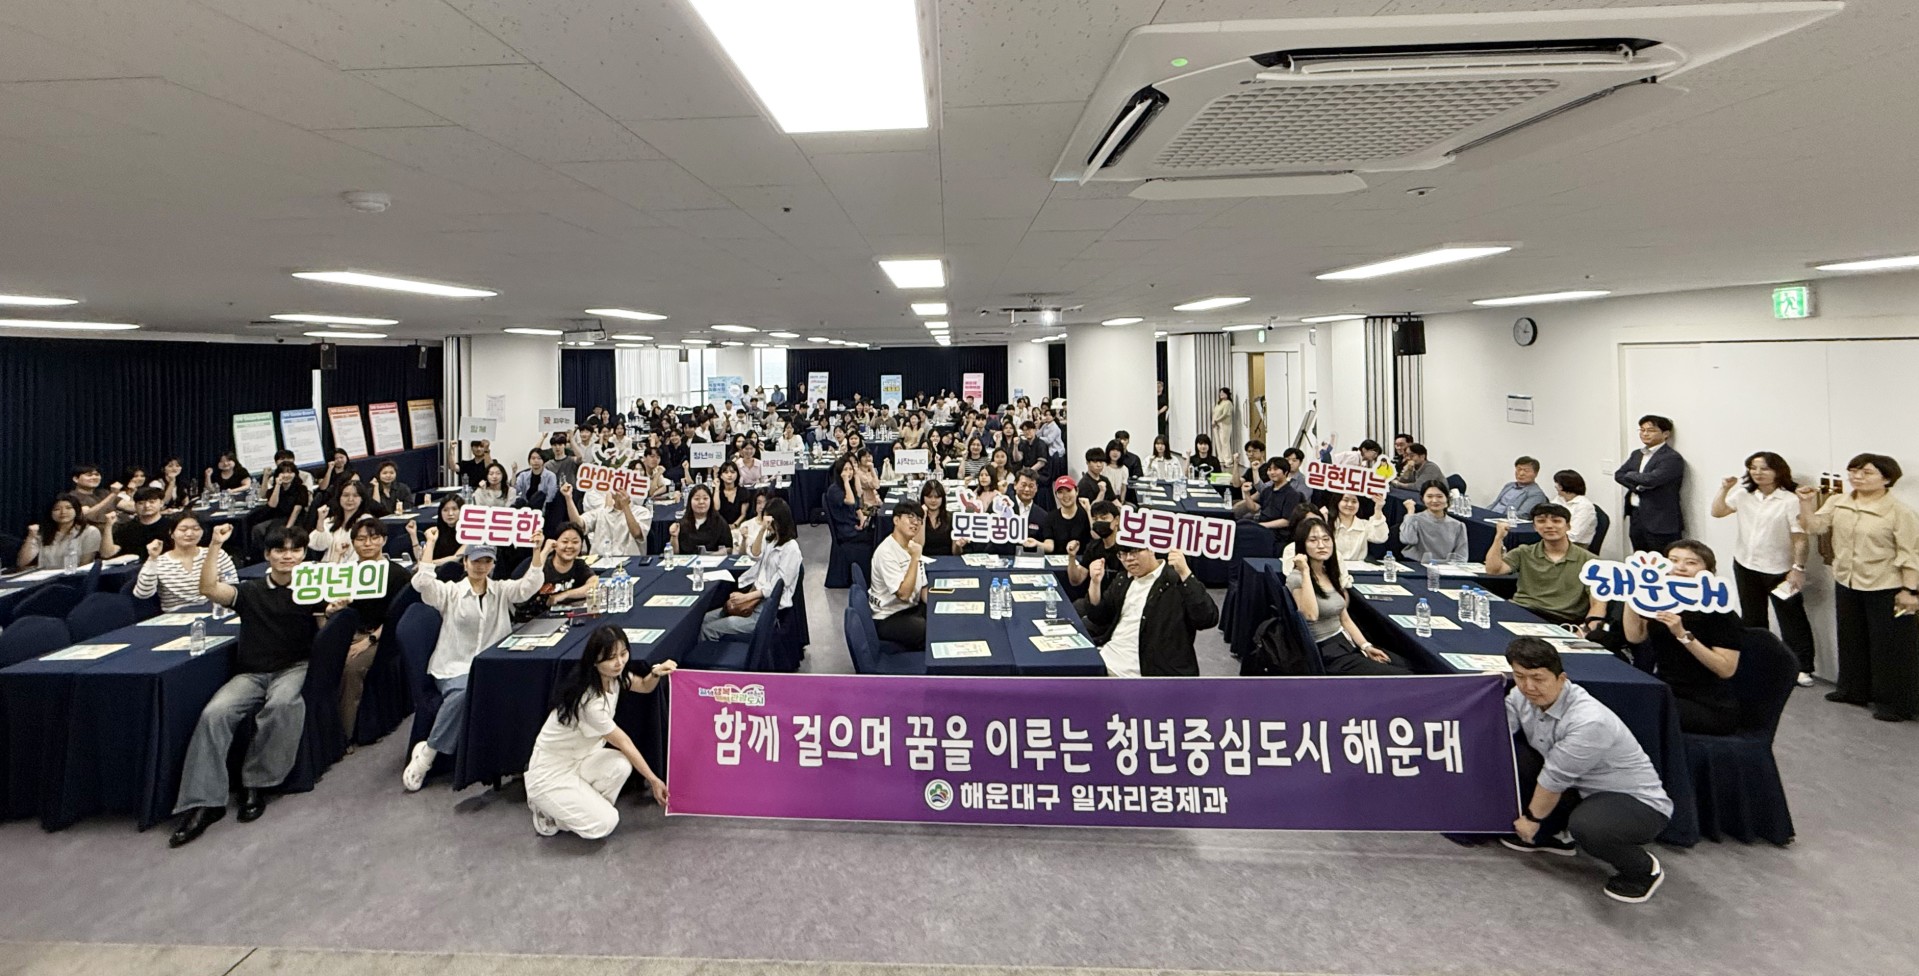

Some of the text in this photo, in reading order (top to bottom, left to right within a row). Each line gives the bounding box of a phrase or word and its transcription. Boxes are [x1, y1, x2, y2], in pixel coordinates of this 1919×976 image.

[693, 451, 714, 460] 청년의
[762, 459, 794, 468] 해운대에서
[579, 465, 647, 497] 상상하는
[1307, 462, 1387, 496] 실현되는
[460, 509, 540, 544] 든든한
[1119, 509, 1231, 557] 보금자리
[295, 564, 385, 601] 청년의
[1585, 564, 1729, 612] 해운대
[713, 706, 1464, 778] 함께 걸으며 꿈을 이루는 청년중심도시 해운대
[960, 782, 1228, 814] 해운대구 일자리경제과
